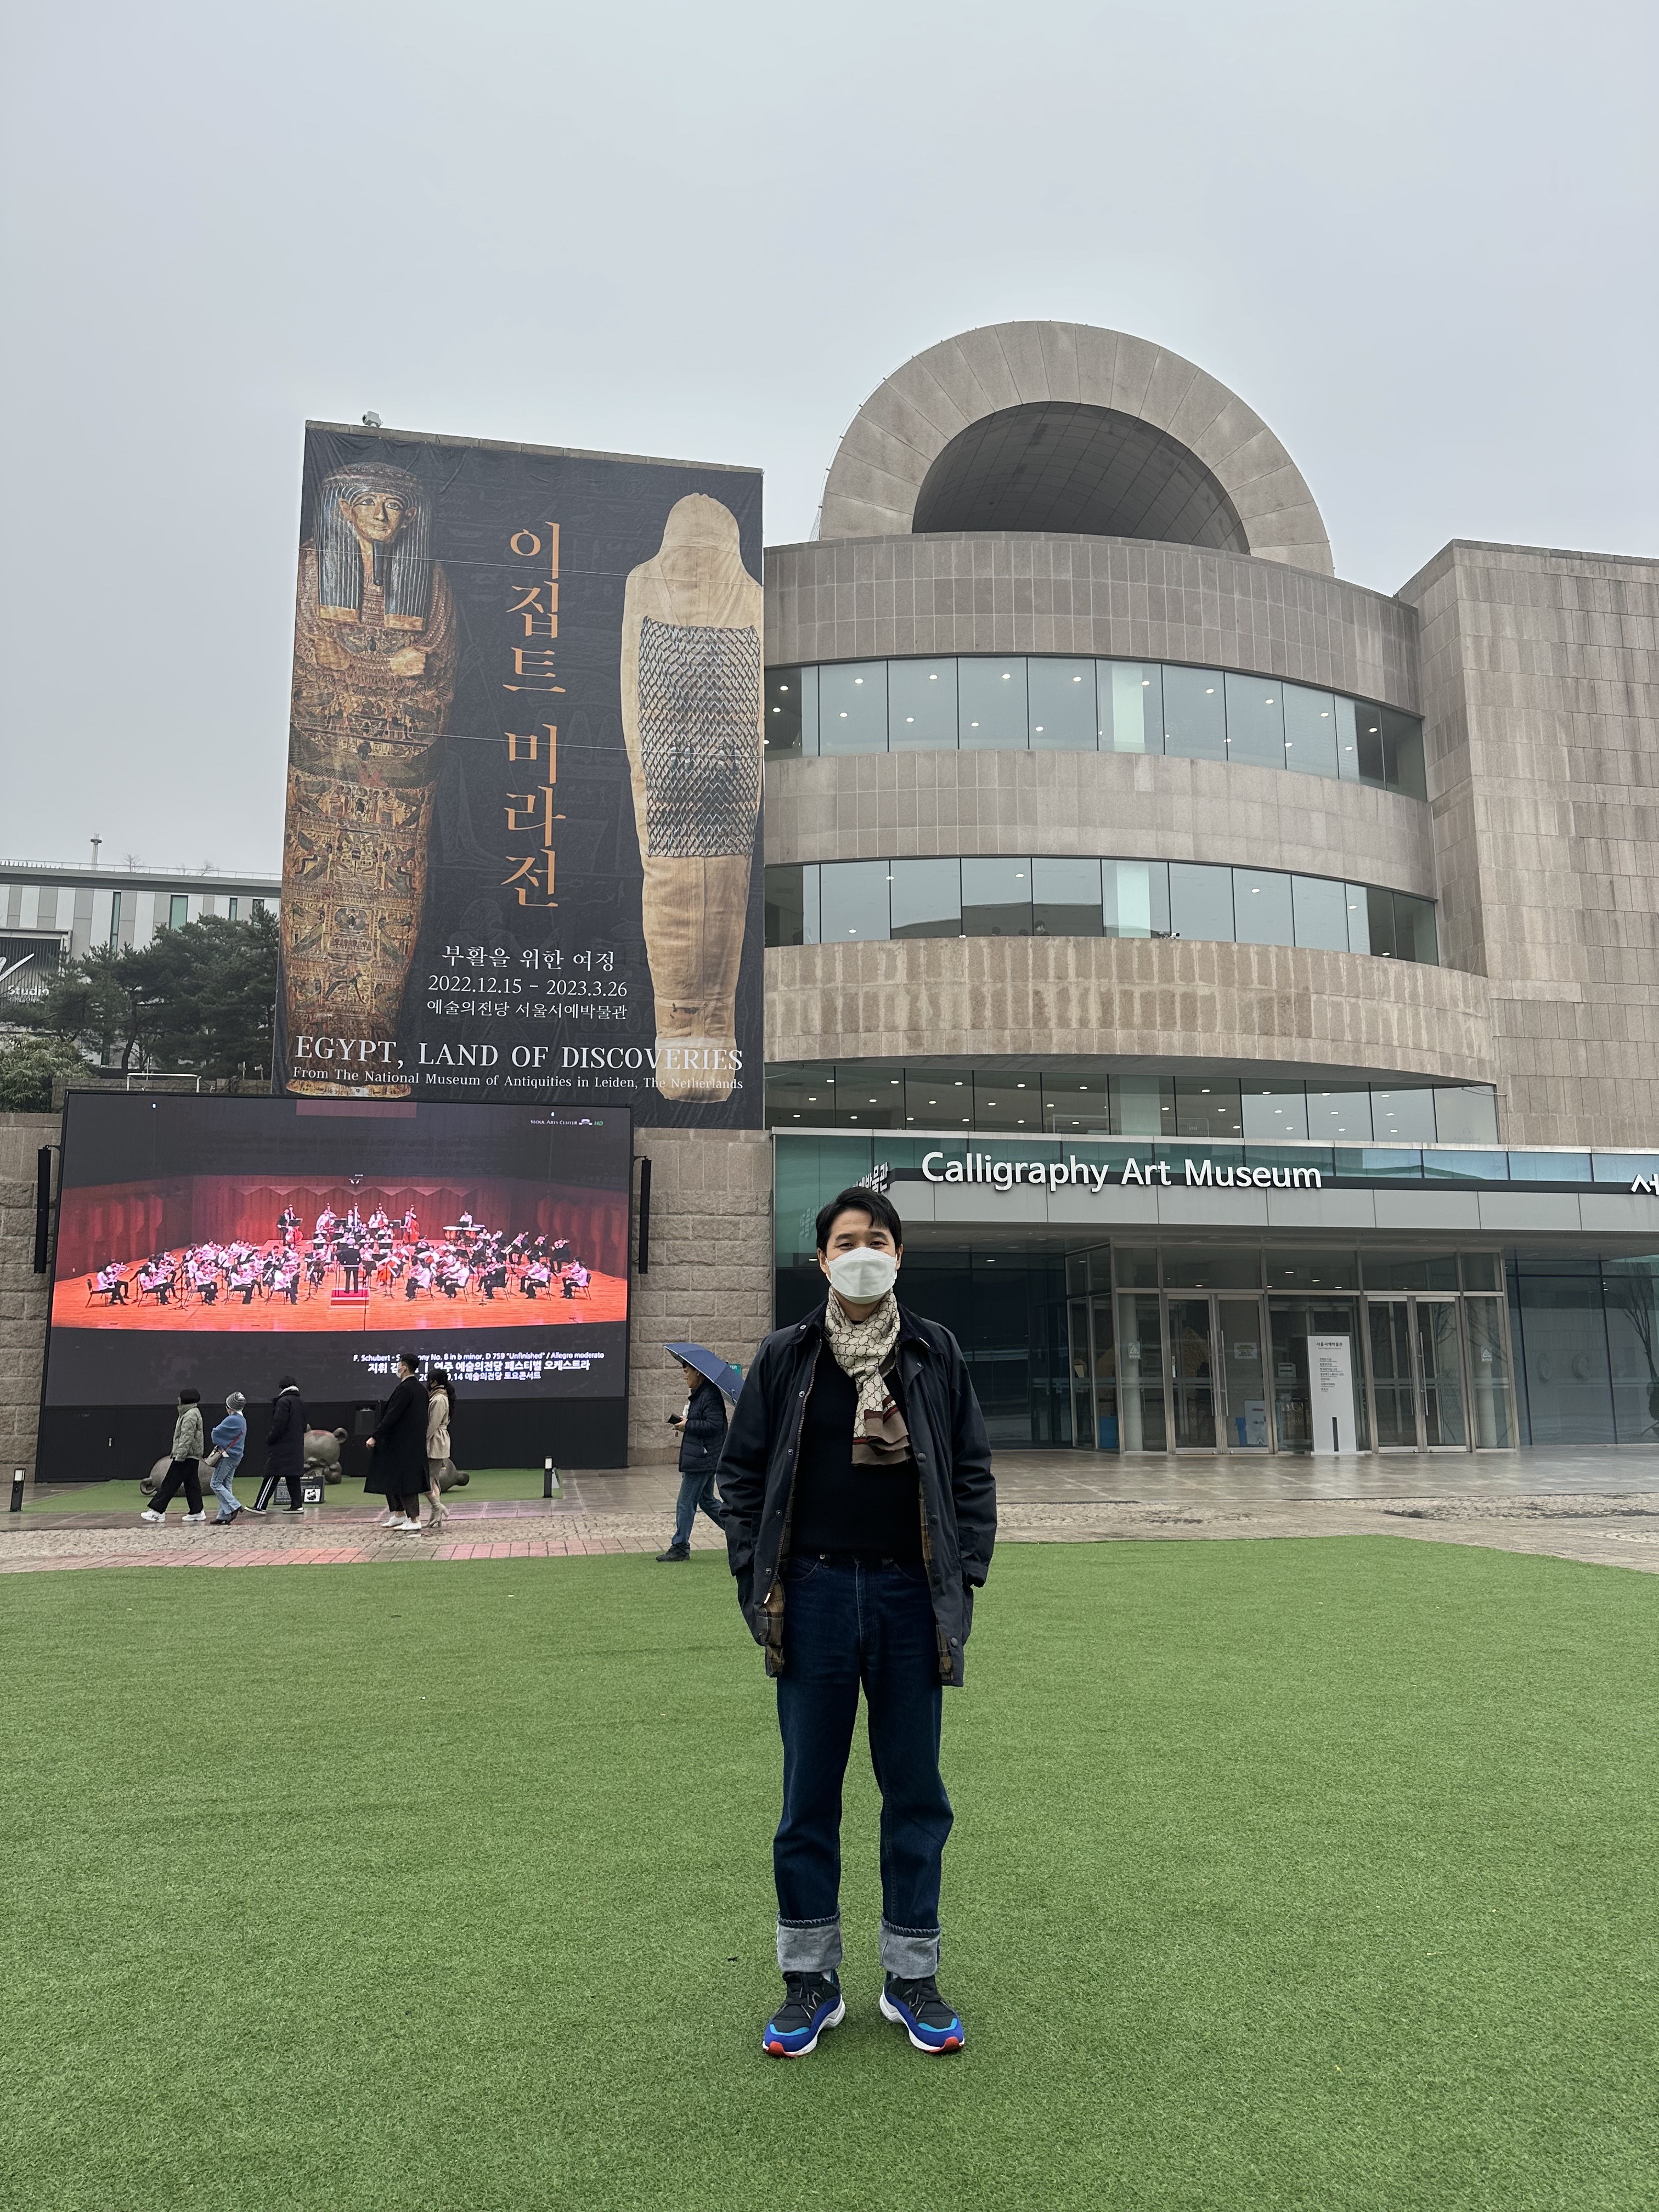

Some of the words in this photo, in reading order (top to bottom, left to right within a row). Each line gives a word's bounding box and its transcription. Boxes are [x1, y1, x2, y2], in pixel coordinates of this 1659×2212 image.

[503, 521, 566, 692] 이집트
[500, 724, 566, 907] 미라전
[442, 945, 511, 968] 부활을
[520, 948, 565, 970] 위한
[573, 950, 614, 972] 여정
[8, 985, 49, 996] Studio
[428, 975, 522, 994] 2022.12.15
[546, 980, 628, 997] 2023.3.26
[427, 999, 510, 1017] 예술의전당
[515, 1002, 628, 1020] 서울서예박물관
[295, 1035, 404, 1069] EGYPT,
[418, 1042, 498, 1066] LAND
[511, 1046, 548, 1068] OF
[561, 1046, 743, 1071] DISCOVERIES
[292, 1066, 329, 1079] From
[335, 1069, 359, 1081] The
[364, 1071, 419, 1084] National
[425, 1073, 481, 1086] Museum
[486, 1075, 499, 1086] of
[504, 1075, 572, 1089] Antiquities
[577, 1076, 589, 1087] in
[594, 1077, 639, 1090] Leiden,
[643, 1077, 665, 1089] The
[671, 1078, 743, 1090] Netherlands
[921, 1152, 1109, 1192] Calligraphy
[1121, 1158, 1172, 1186] Art
[1184, 1159, 1323, 1189] Museum
[368, 1362, 388, 1374] 지휘
[455, 1361, 503, 1372] 예술의전당
[504, 1360, 542, 1372] 페스티벌
[544, 1359, 591, 1370] 오케스트라
[550, 1351, 573, 1359] Allegro
[465, 1372, 503, 1381] 예술의전당
[504, 1371, 541, 1380] 토요콘서트
